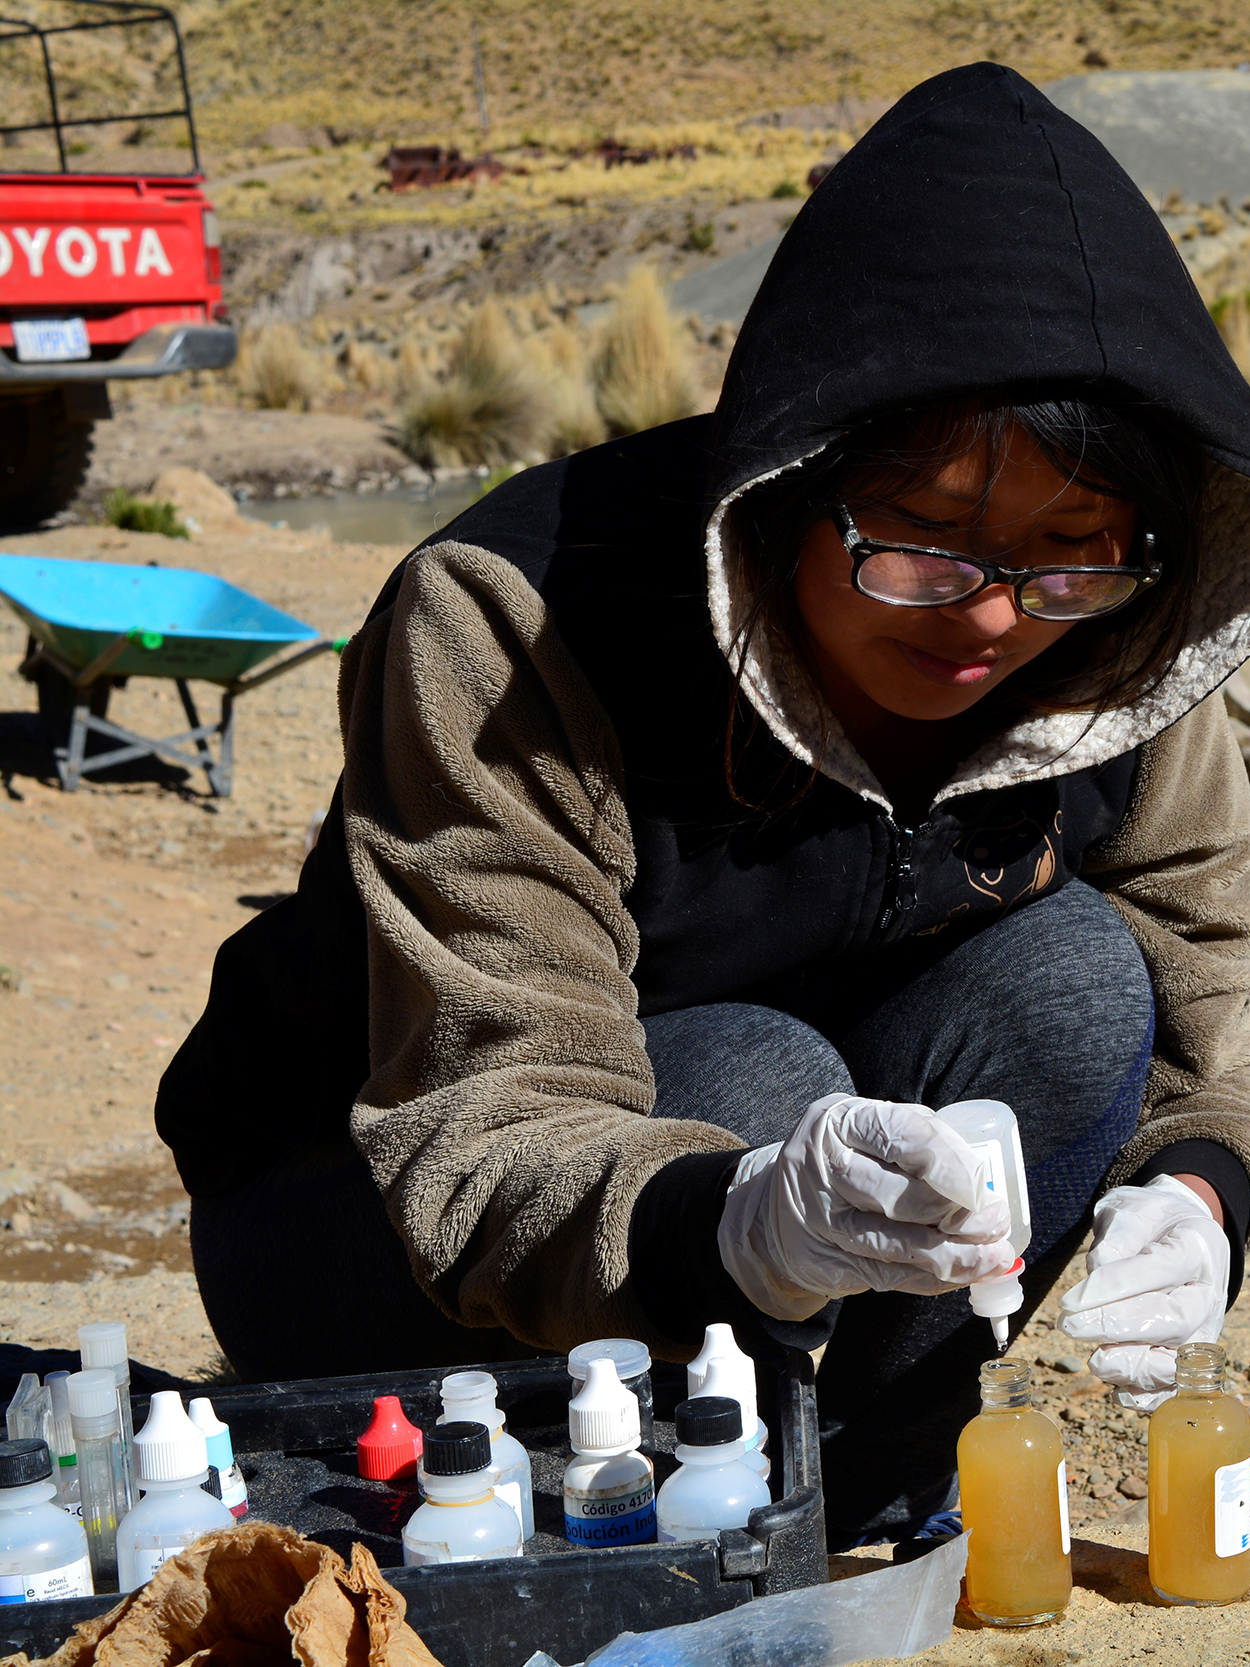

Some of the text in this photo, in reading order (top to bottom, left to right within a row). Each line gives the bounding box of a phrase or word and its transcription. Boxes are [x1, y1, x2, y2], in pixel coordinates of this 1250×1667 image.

[582, 1503, 626, 1516] Código
[566, 1522, 630, 1540] Solución
[48, 1576, 67, 1587] 60mL
[27, 1588, 35, 1598] e
